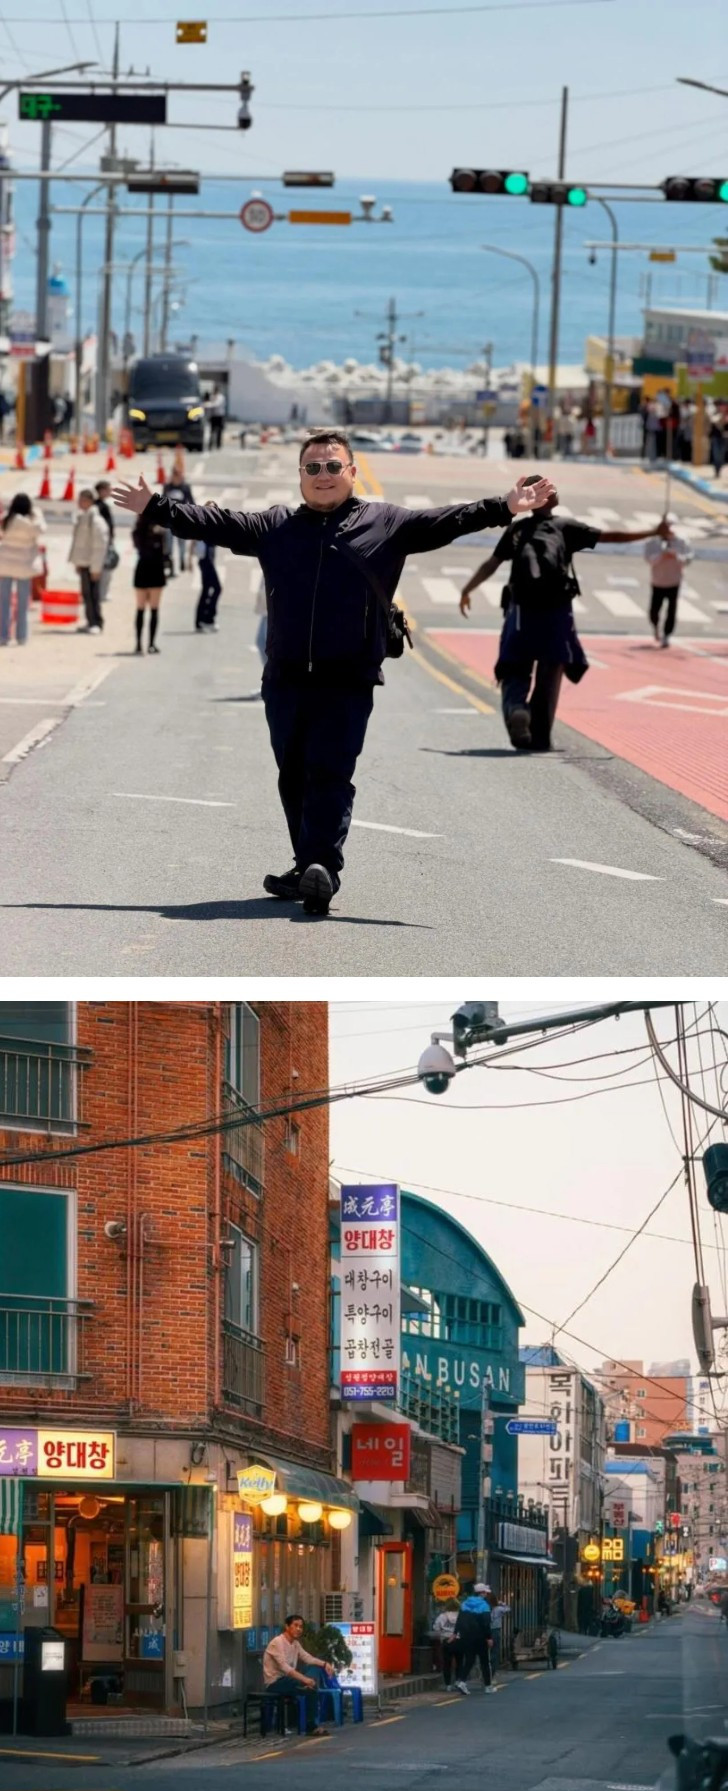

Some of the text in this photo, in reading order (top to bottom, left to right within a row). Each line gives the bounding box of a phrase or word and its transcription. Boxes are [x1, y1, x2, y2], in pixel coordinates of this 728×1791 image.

[344, 1229, 395, 1250] 양대창
[344, 1269, 393, 1291] 대창구이
[344, 1304, 393, 1325] 특양구이
[437, 1357, 510, 1392] BUSAN
[43, 1441, 110, 1469] 양대창
